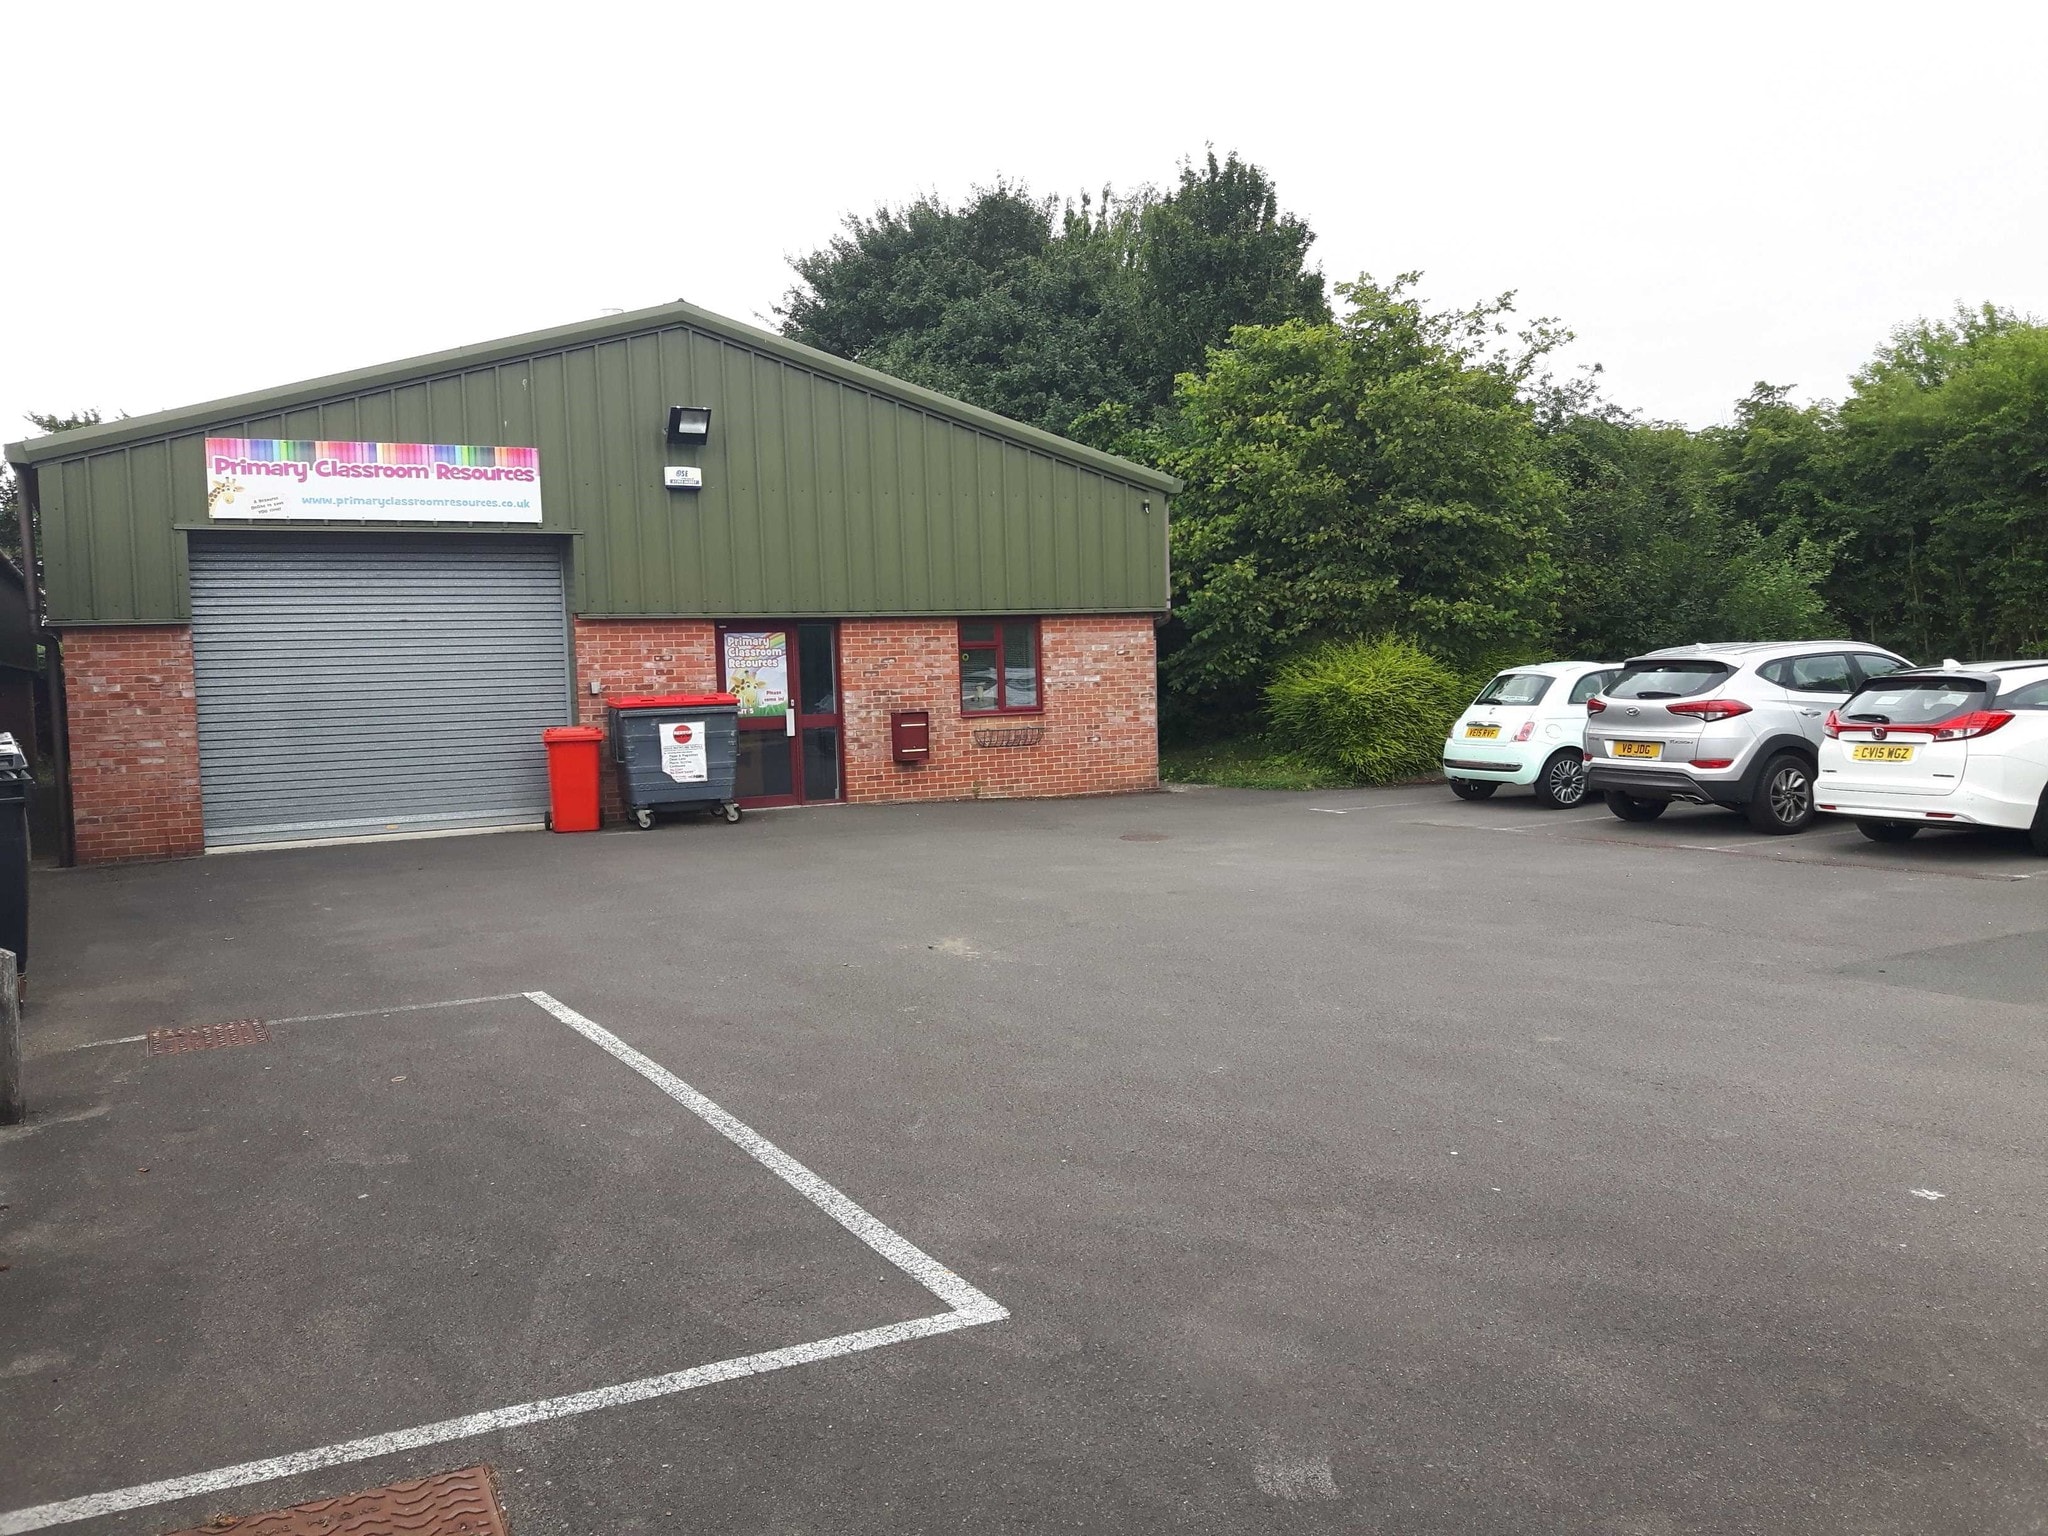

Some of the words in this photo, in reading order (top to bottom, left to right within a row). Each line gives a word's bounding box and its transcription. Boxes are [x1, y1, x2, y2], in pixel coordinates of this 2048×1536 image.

[214, 457, 308, 483] Primary
[315, 460, 430, 479] Classroom
[436, 463, 535, 482] Resources
[302, 496, 530, 508] www.primaryclassroomresources.co.uk
[727, 636, 770, 648] Primary
[728, 647, 782, 657] Classroom
[728, 659, 778, 668] Resources
[1622, 744, 1632, 754] V8
[1634, 744, 1651, 754] JDG
[1861, 747, 1885, 759] CV15
[1887, 748, 1909, 759] WGZ
